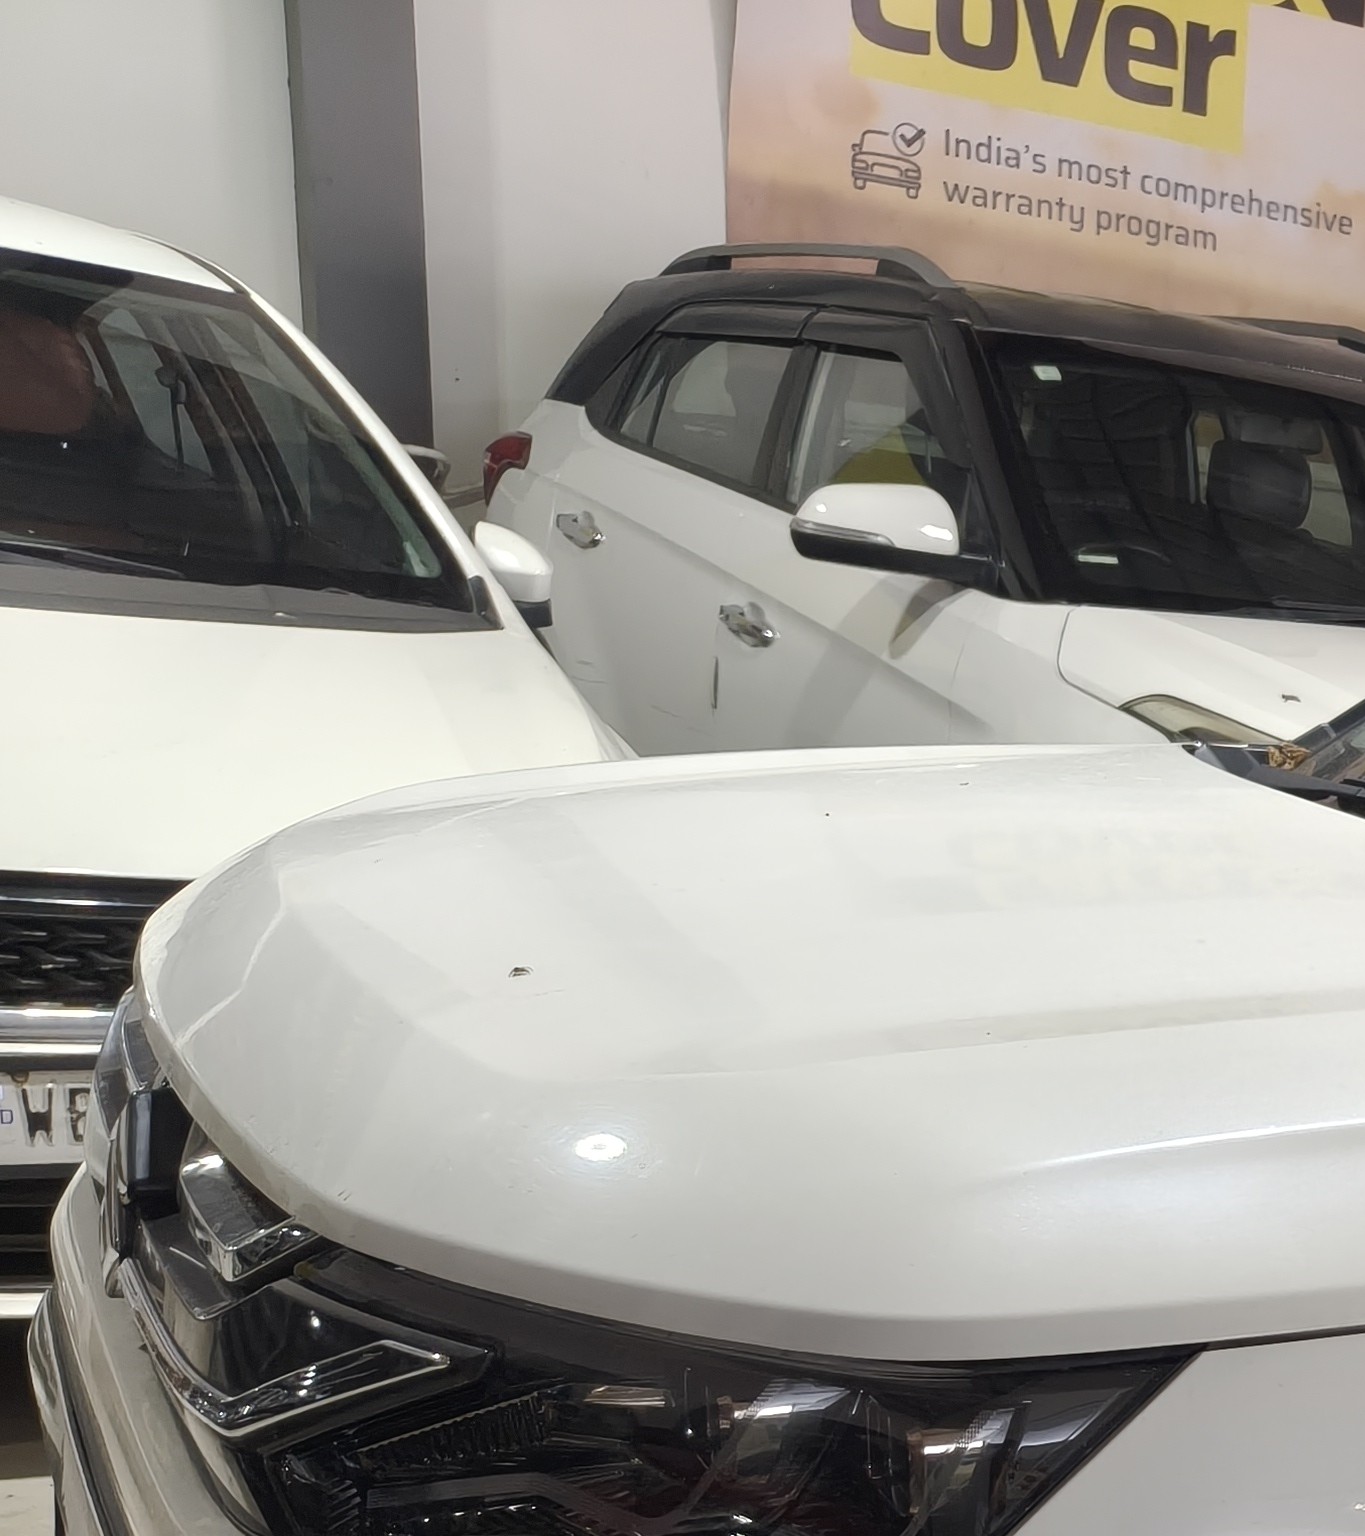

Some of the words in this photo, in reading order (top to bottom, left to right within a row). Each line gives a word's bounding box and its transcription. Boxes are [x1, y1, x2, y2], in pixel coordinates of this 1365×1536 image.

[943, 181, 1084, 233] warranty
[1096, 208, 1217, 252] program
[1057, 156, 1130, 190] most
[1140, 173, 1353, 236] comprehensive
